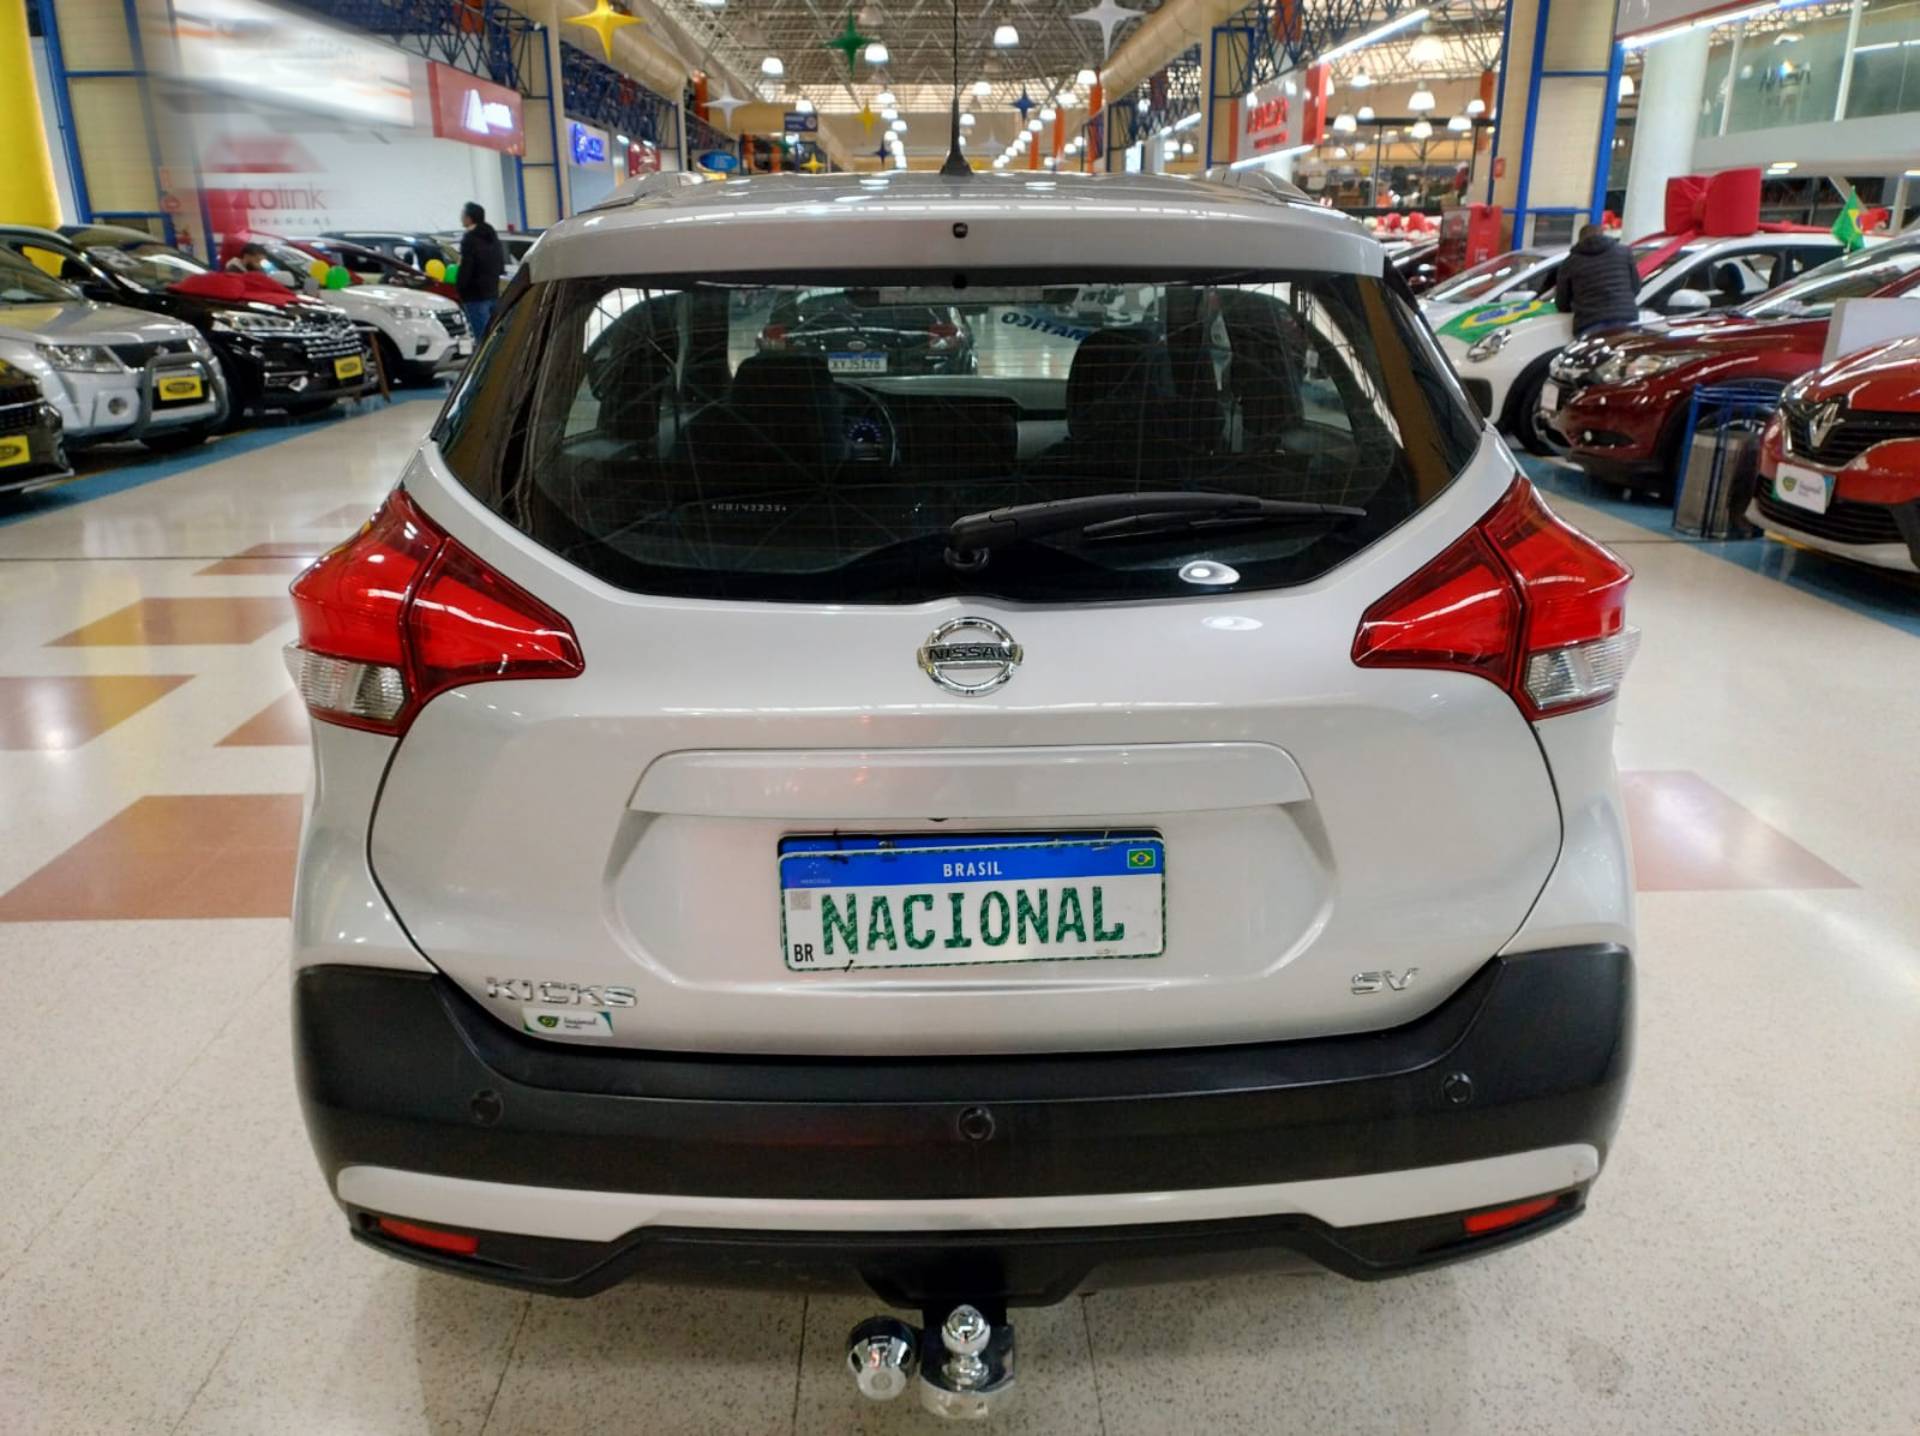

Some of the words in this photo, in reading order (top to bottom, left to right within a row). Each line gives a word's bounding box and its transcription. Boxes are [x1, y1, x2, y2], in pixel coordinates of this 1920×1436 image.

[928, 645, 1012, 660] NISSAN
[943, 862, 1002, 877] BRASIL
[821, 886, 1125, 955] NACIONAL
[793, 943, 814, 963] BR
[486, 977, 637, 1008] KICKS
[1351, 967, 1418, 995] SV
